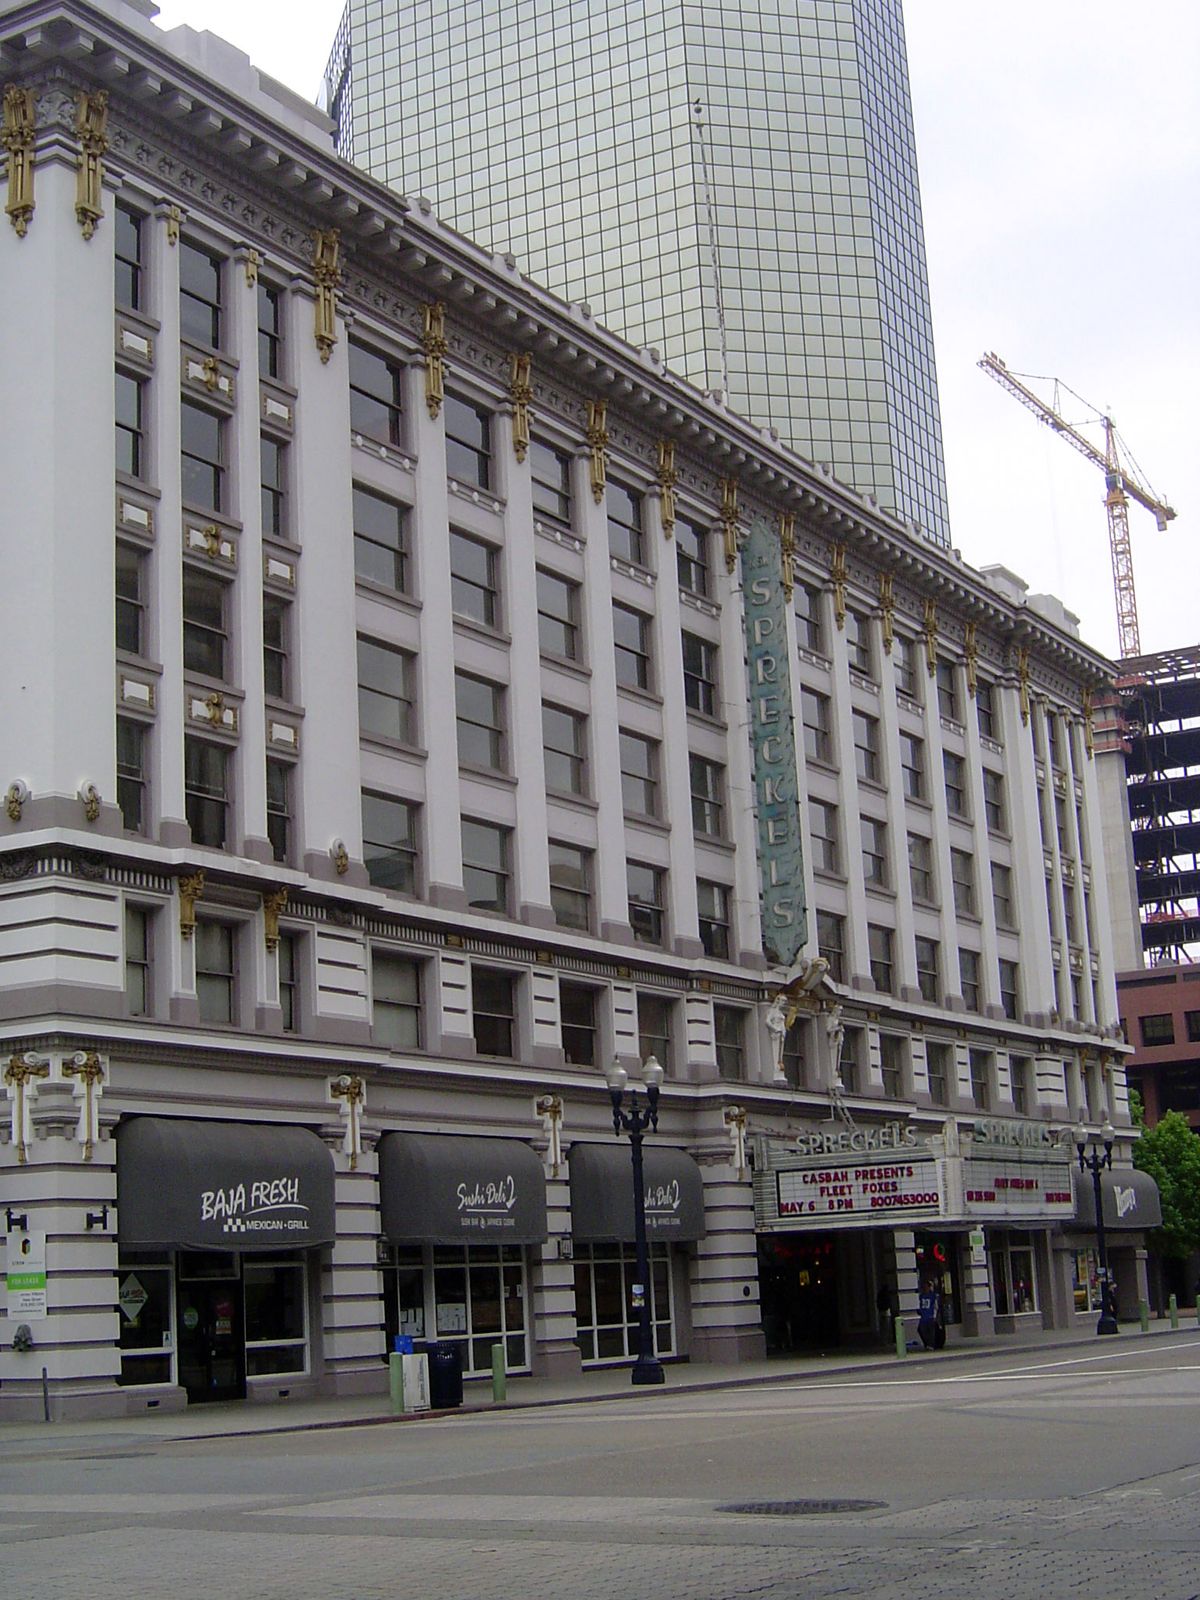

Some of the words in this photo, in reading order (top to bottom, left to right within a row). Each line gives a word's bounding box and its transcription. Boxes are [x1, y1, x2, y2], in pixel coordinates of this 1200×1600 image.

[751, 576, 795, 929] SPRECKELS
[796, 1126, 918, 1155] SPRECKELS
[802, 1171, 848, 1184] CASBAH
[855, 1166, 914, 1180] PRESENTS
[201, 1183, 246, 1220] BAJA
[251, 1177, 299, 1207] FRESH
[457, 1183, 485, 1210] Sushi
[486, 1180, 506, 1204] Deli
[656, 1184, 672, 1206] Deli
[820, 1184, 853, 1197] FLEET
[862, 1181, 898, 1194] FOXES
[780, 1201, 804, 1213] MAY
[808, 1201, 816, 1212] 6
